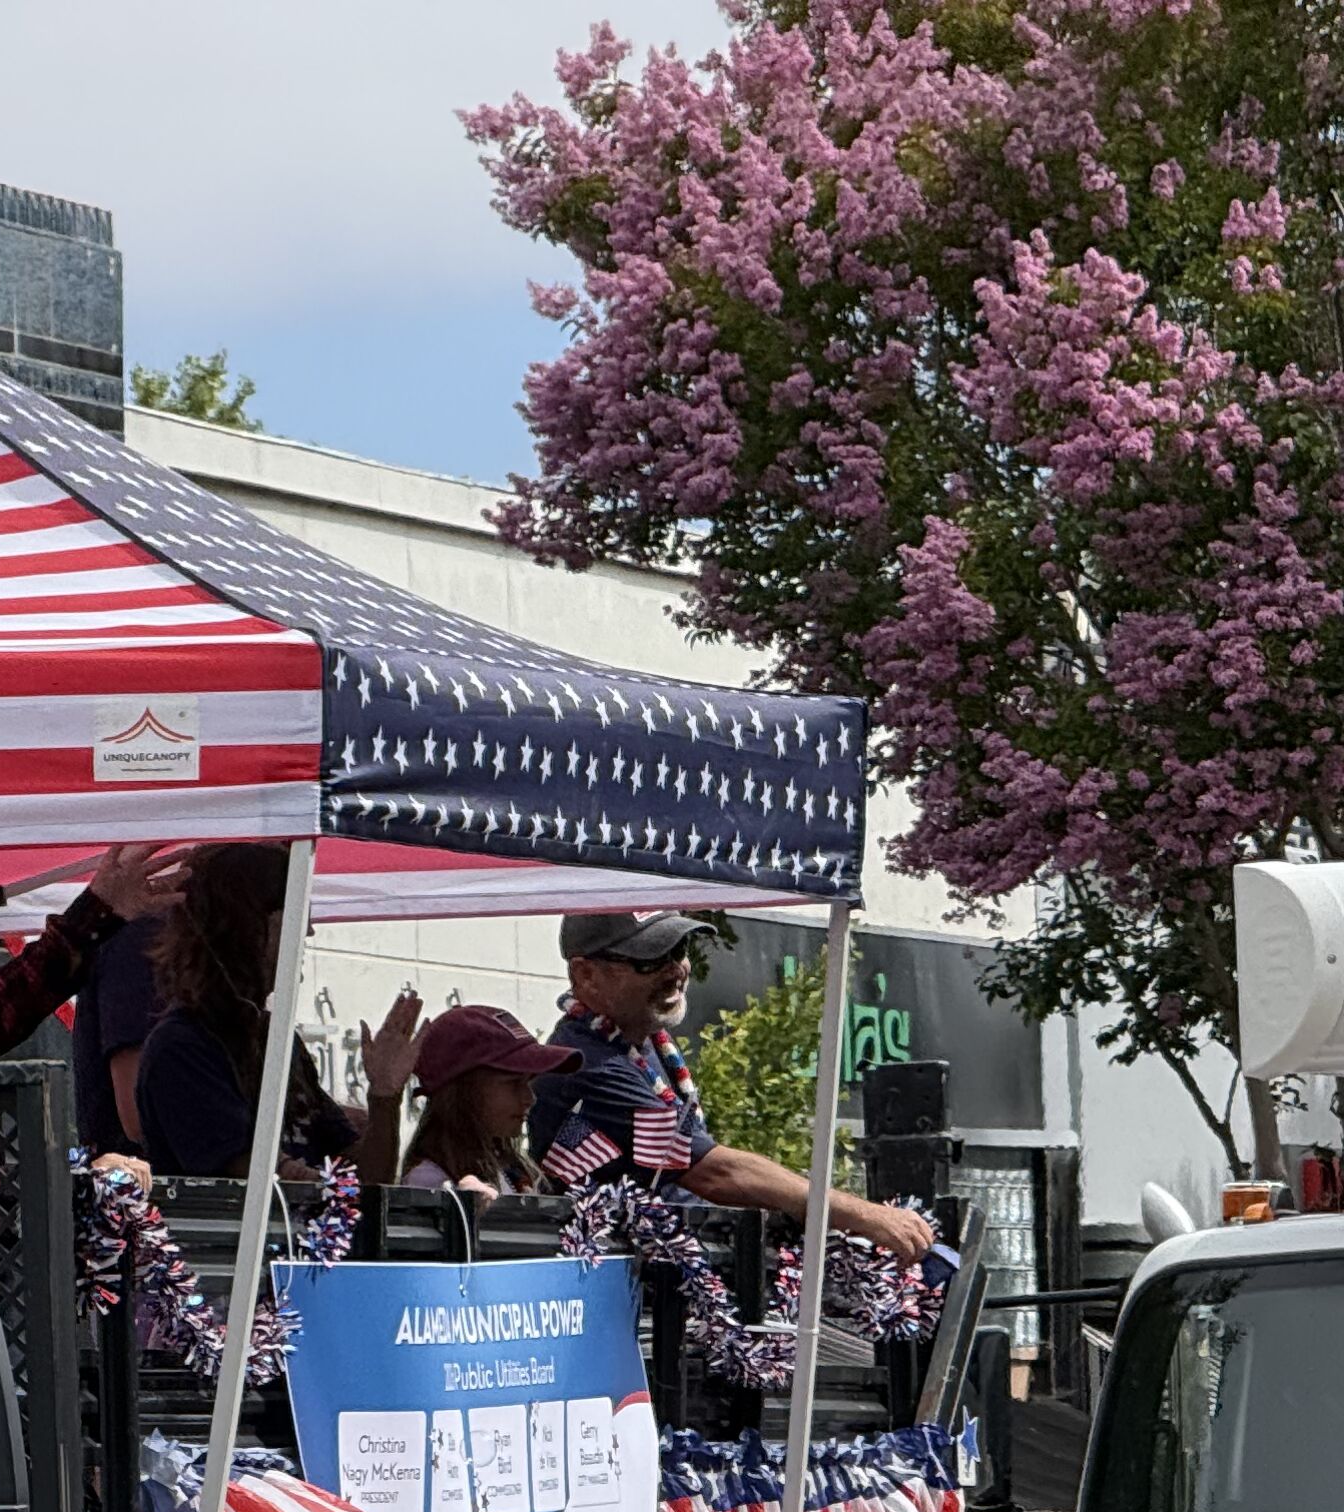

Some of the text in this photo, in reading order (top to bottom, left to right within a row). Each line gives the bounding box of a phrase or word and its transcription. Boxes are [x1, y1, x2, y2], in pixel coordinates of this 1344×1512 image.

[103, 752, 191, 763] UNIQUECANOPY
[452, 1301, 539, 1344] MUNICIPAL
[540, 1299, 584, 1338] POWER
[454, 1361, 493, 1390] Public
[358, 1434, 406, 1454] Christina
[342, 1462, 421, 1486] Nagy McKenna
